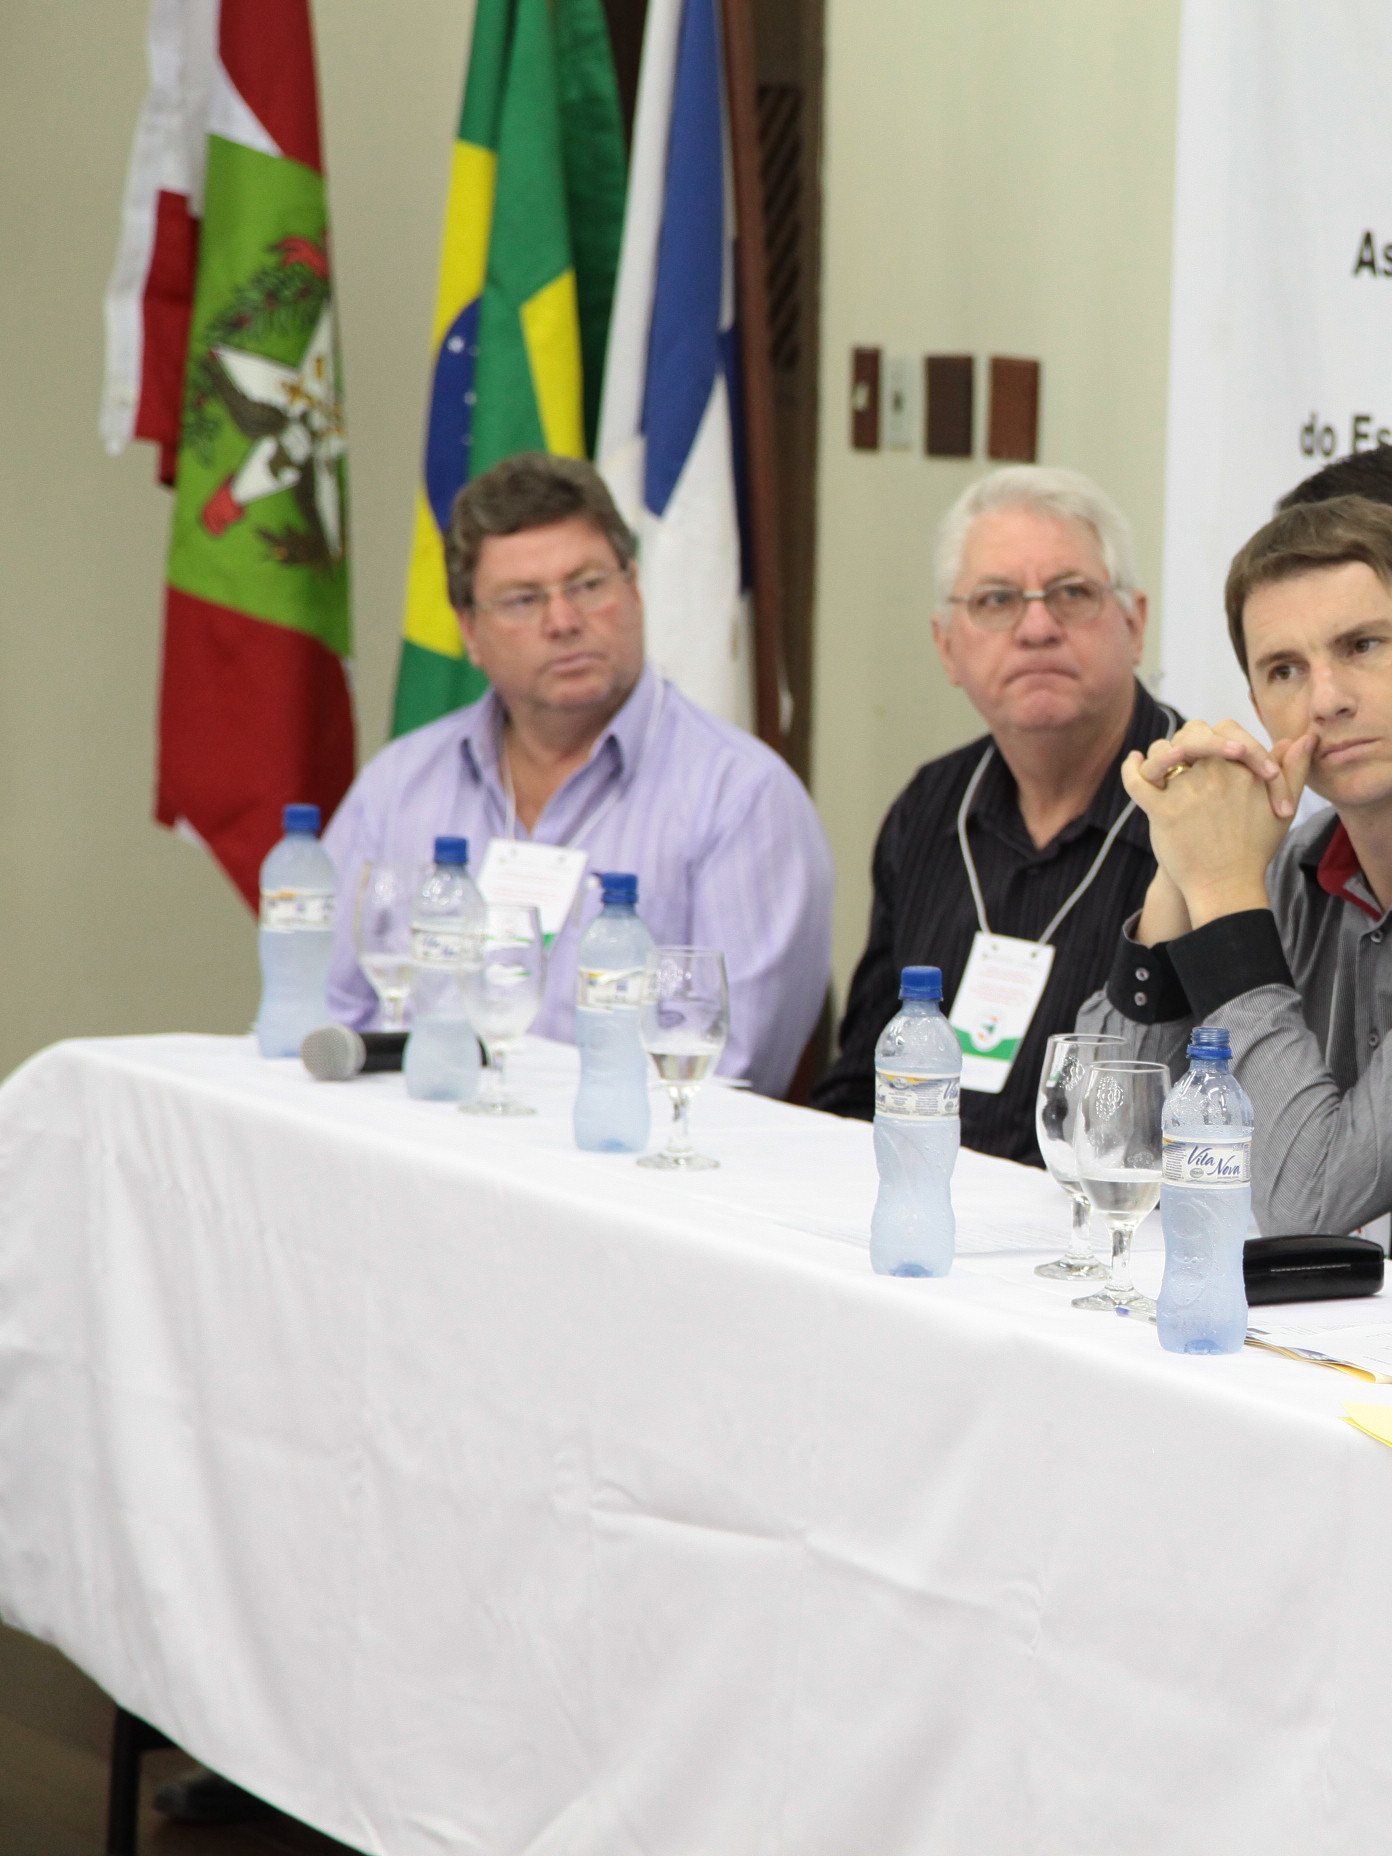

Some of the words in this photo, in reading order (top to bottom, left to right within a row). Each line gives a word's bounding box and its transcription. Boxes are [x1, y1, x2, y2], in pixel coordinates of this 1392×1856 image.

[1301, 412, 1336, 458] do
[1188, 1146, 1215, 1166] Vila
[1207, 1155, 1240, 1176] Nova
